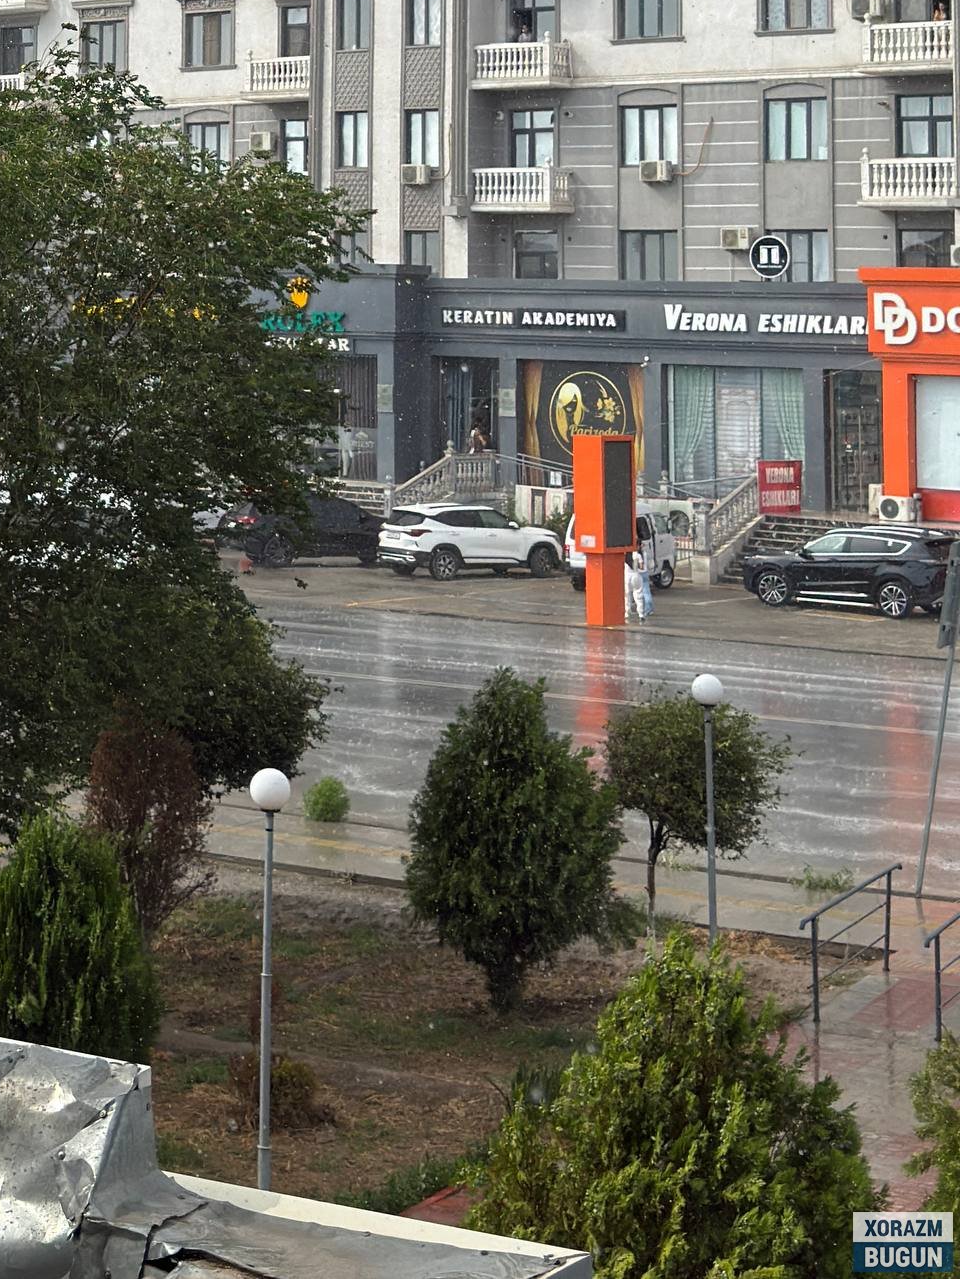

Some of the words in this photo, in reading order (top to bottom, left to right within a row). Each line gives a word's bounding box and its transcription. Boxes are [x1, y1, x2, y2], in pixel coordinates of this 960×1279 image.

[442, 309, 514, 325] KERATIN
[521, 311, 617, 328] AKADEMIYA
[663, 304, 748, 333] VERONA
[765, 466, 794, 484] VERONA
